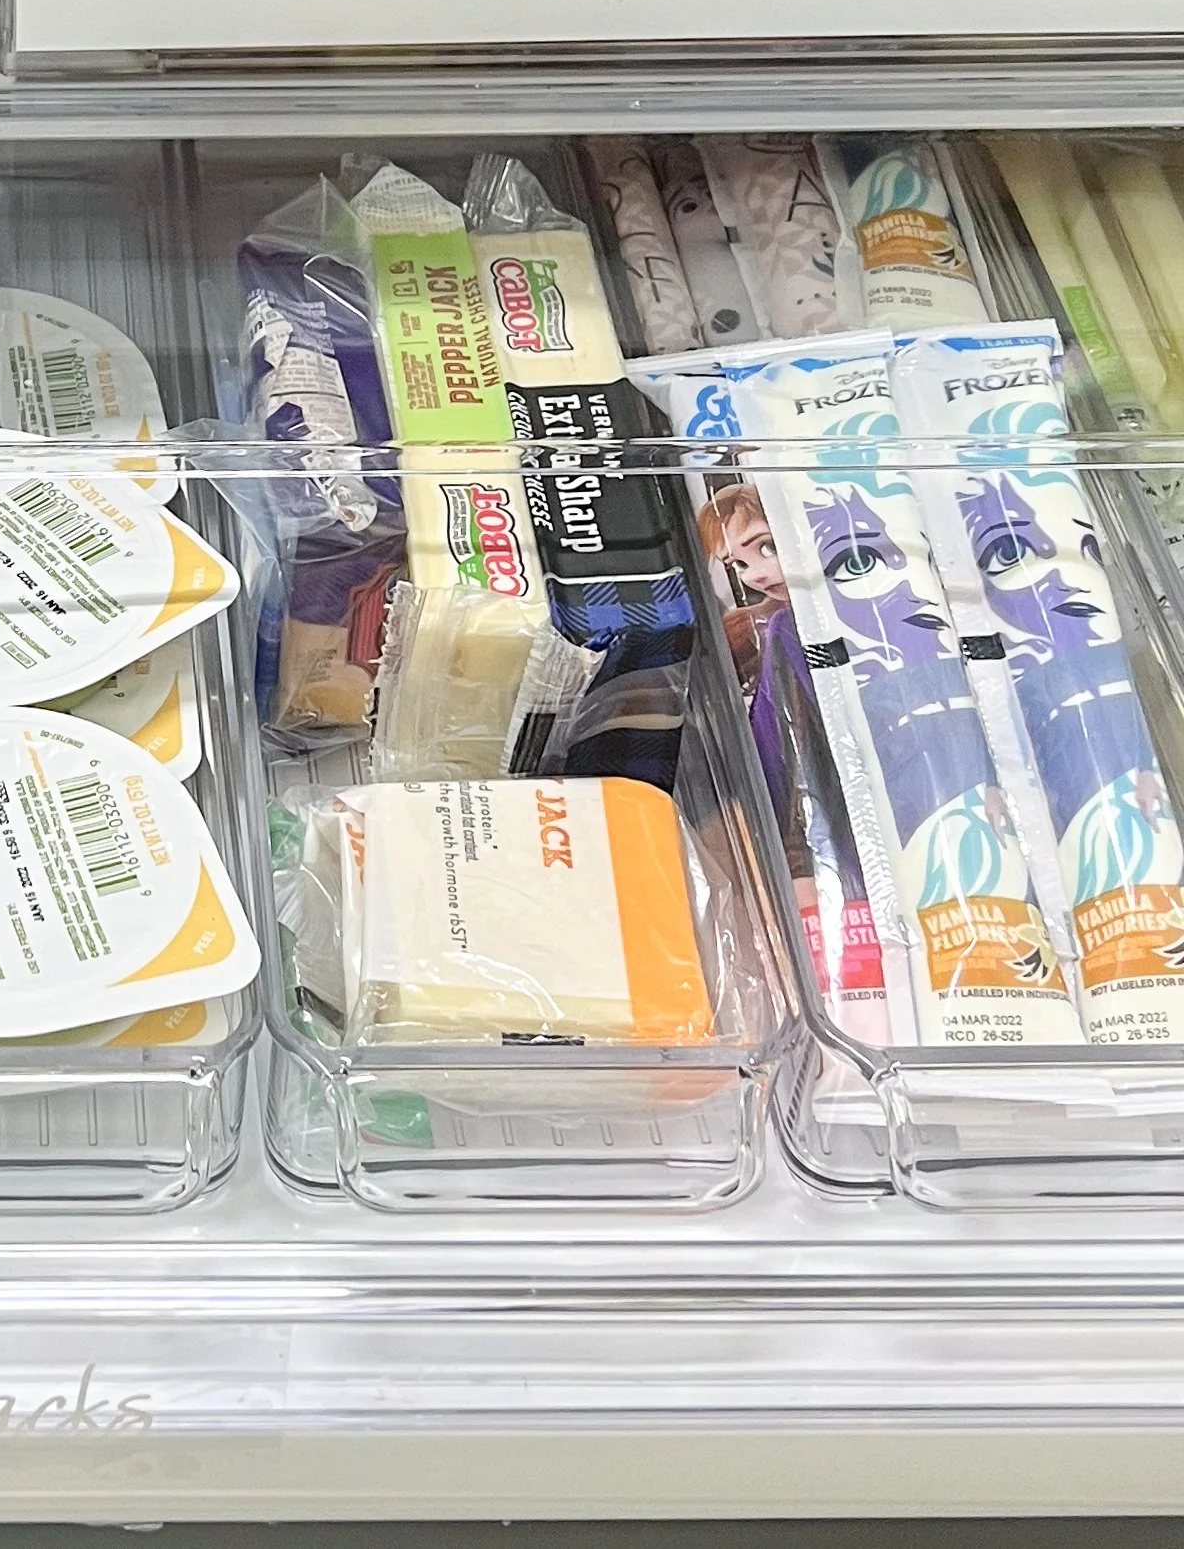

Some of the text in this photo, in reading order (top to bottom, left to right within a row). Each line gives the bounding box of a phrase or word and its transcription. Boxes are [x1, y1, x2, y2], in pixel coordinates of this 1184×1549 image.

[424, 265, 483, 404] PEPPER JACK
[463, 275, 500, 388] NATURAL CHEESE
[41, 481, 79, 513] 03290
[555, 476, 604, 552] Sharp
[44, 598, 66, 615] JAN
[95, 784, 123, 828] 03290
[146, 828, 164, 846] WT
[536, 790, 573, 868] JACK
[114, 831, 141, 873] 16112
[436, 782, 459, 910] the growth hormone
[153, 847, 171, 867] NET
[17, 867, 32, 887] 2022
[25, 892, 36, 902] 15
[29, 903, 44, 922] JAN
[1085, 912, 1167, 951] FLURRIES
[194, 929, 217, 955] PEEL
[961, 989, 1024, 998] LABELED FOR
[1091, 978, 1176, 997] NOT LABELED FOR
[943, 1015, 1022, 1026] 04 MAR 2022
[1090, 1012, 1168, 1032] 04 MAR 2022
[946, 1031, 975, 1041] RCD
[1091, 1031, 1120, 1045] RCD
